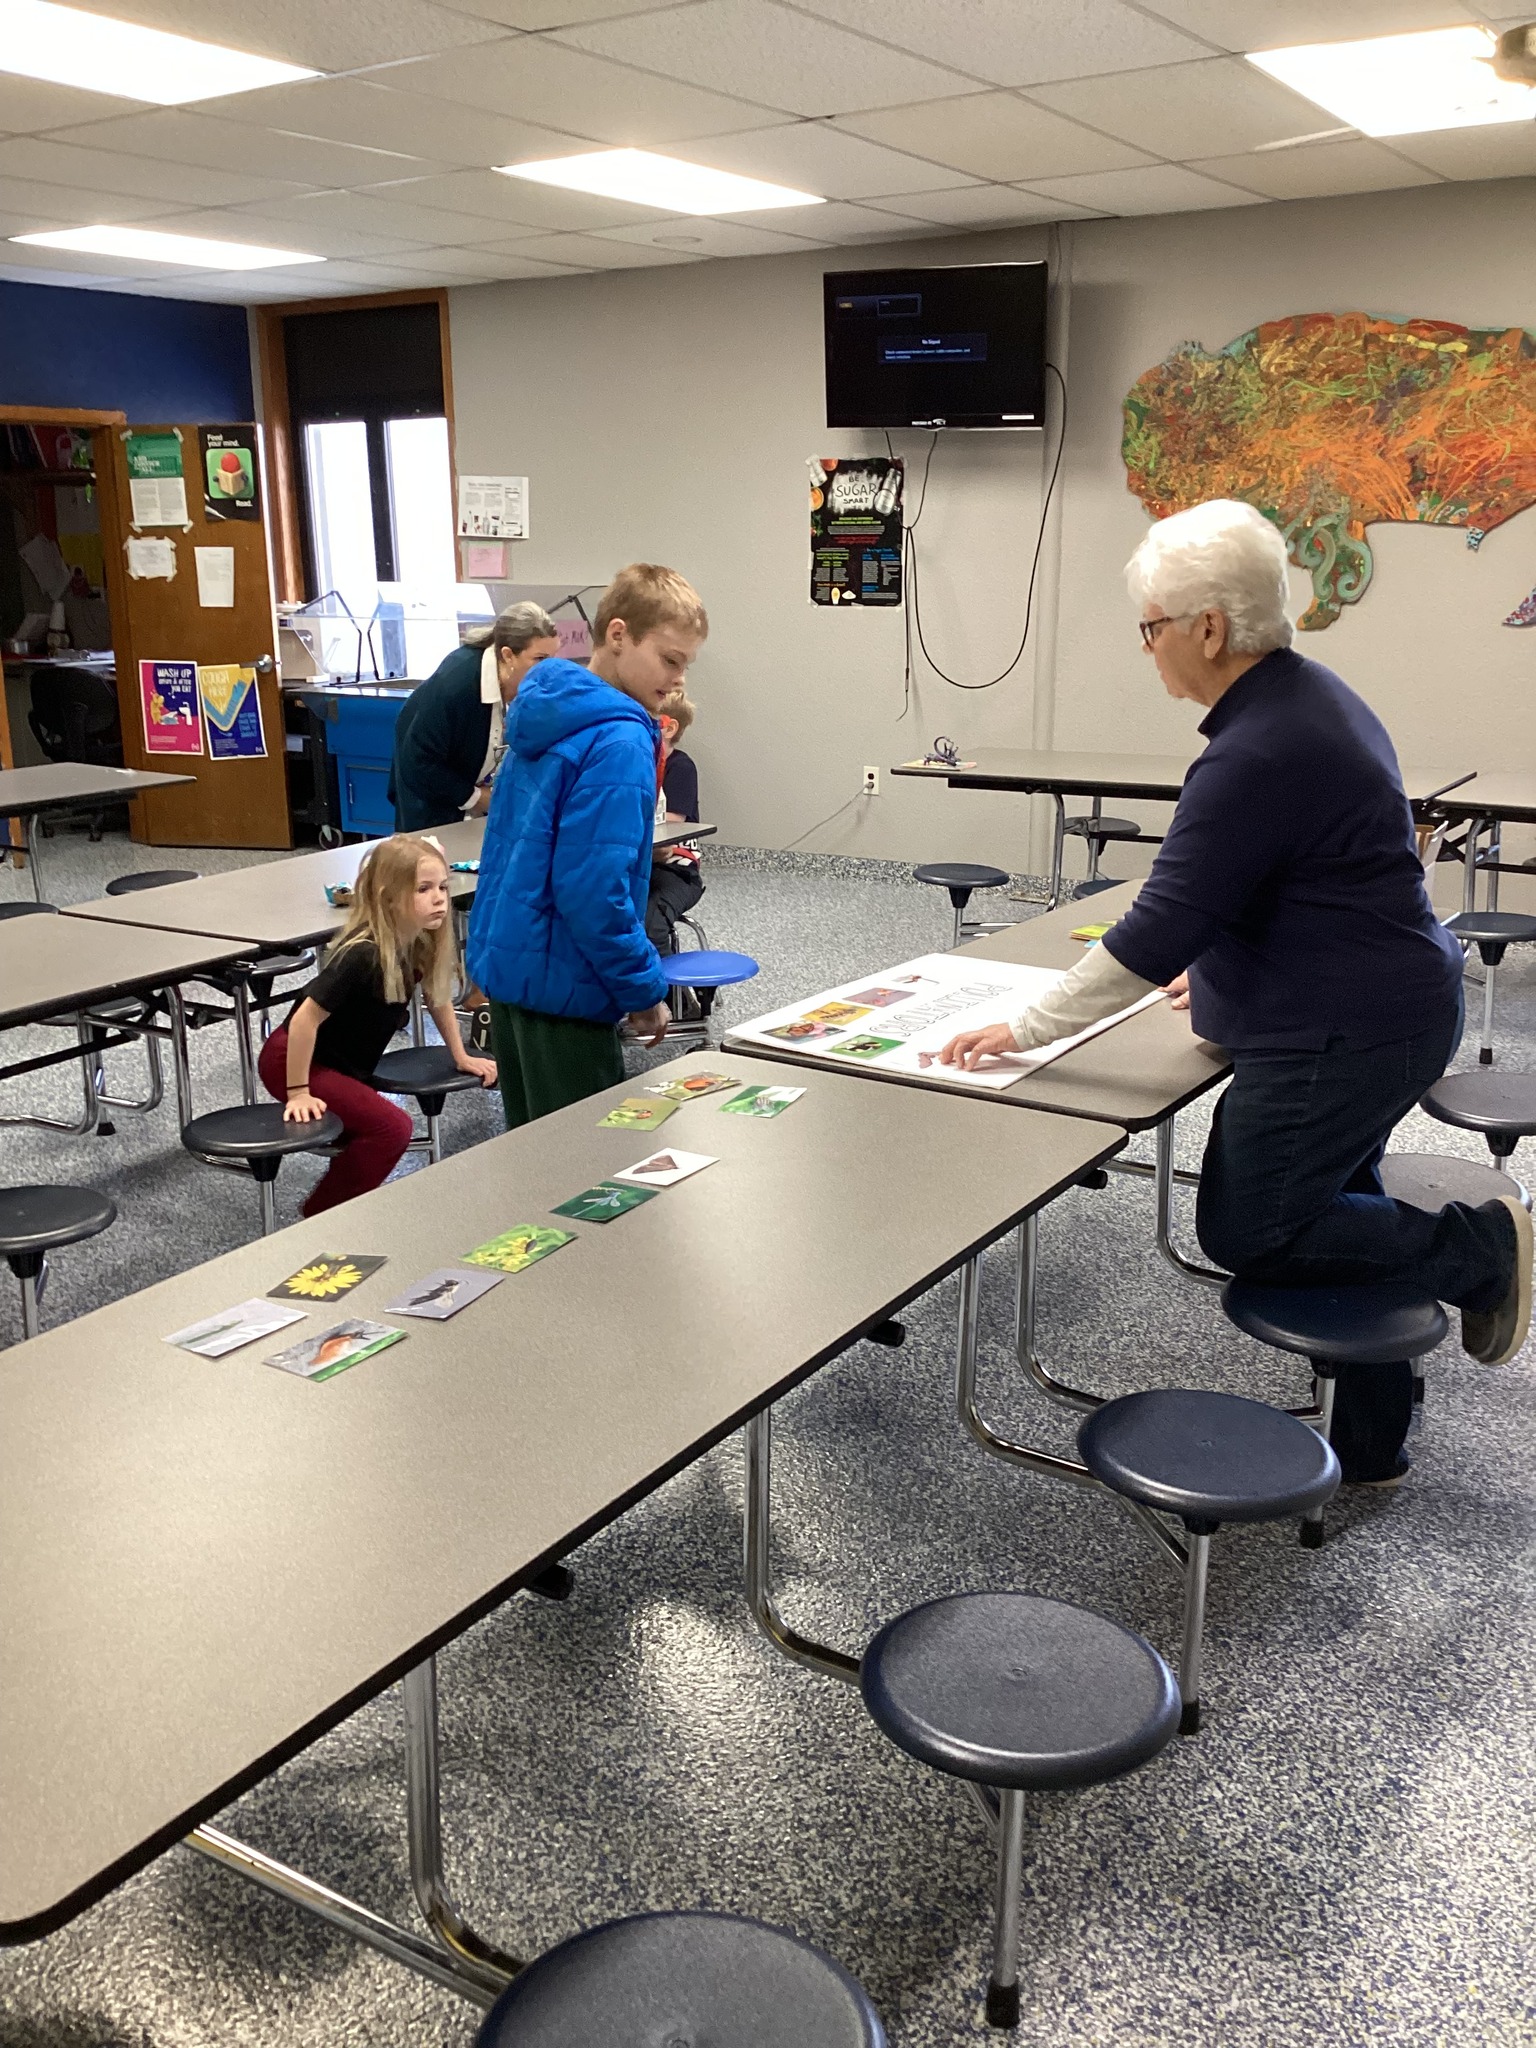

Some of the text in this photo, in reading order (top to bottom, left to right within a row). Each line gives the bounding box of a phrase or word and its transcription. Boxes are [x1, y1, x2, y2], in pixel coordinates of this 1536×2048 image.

[836, 483, 877, 497] SUGAR
[157, 668, 192, 678] WASH UP
[869, 982, 1014, 1037] POLLINATORS
